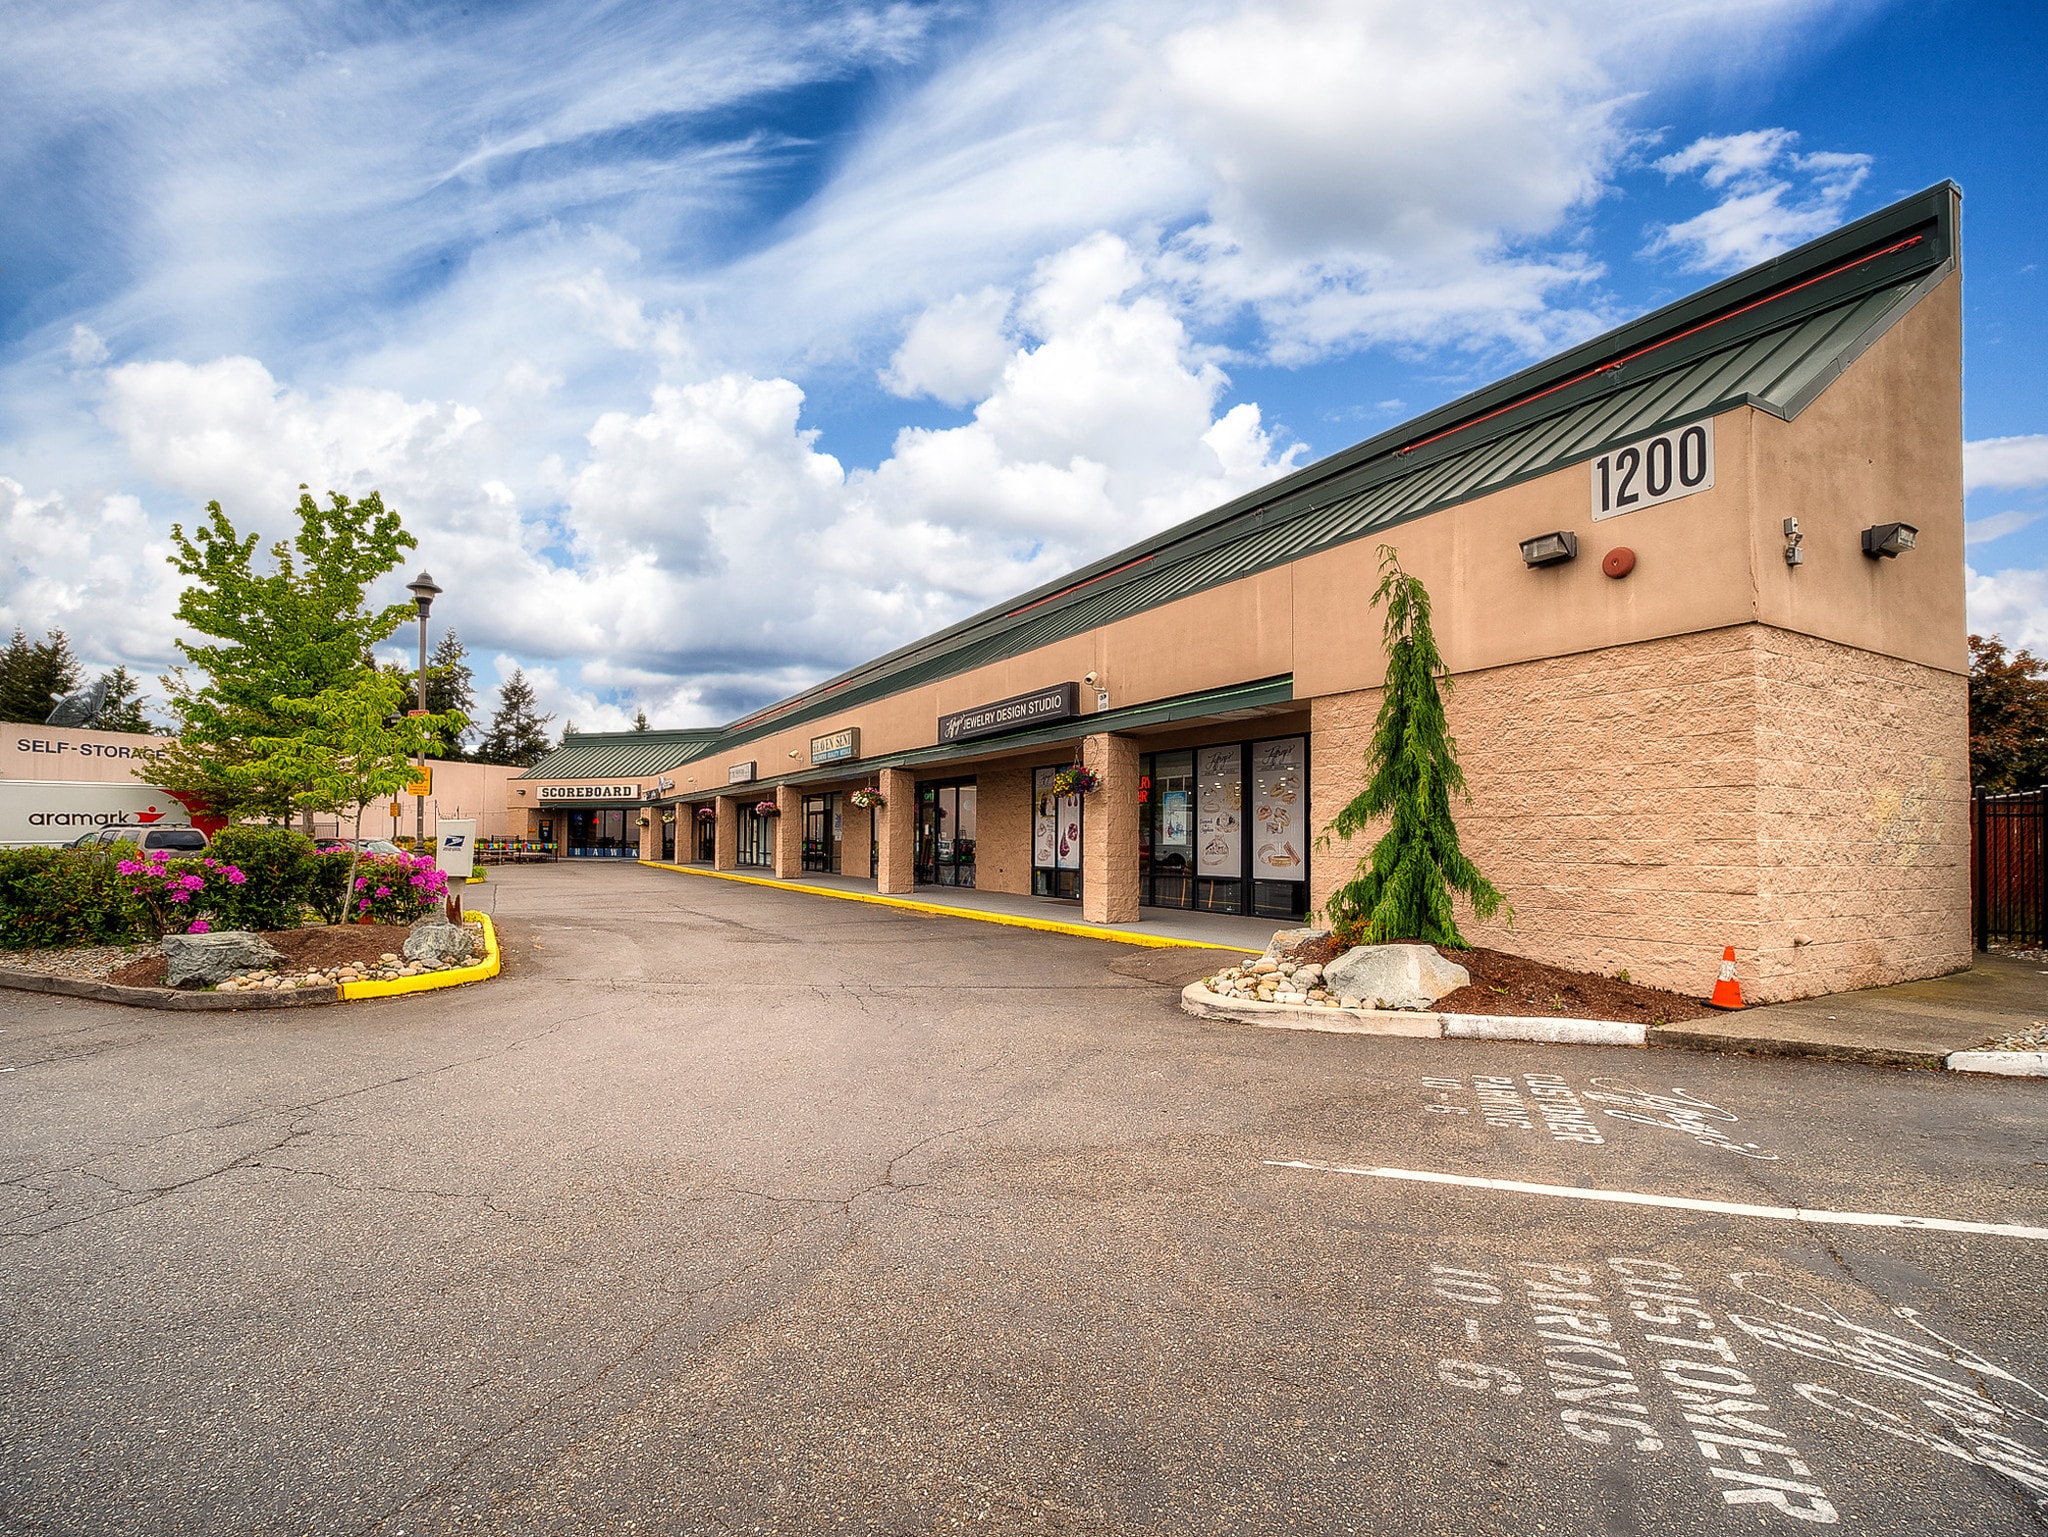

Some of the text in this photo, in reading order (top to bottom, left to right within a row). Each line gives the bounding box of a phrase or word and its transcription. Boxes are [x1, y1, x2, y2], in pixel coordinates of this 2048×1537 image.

[1597, 425, 1707, 512] 1200
[963, 711, 995, 730] JEWELRY
[996, 703, 1027, 722] DESIGN
[1028, 695, 1062, 716] STUDIO
[28, 810, 130, 826] aramark
[542, 786, 632, 798] SCOREBOARD
[1471, 1075, 1534, 1129] PARKING
[1523, 1073, 1606, 1144] CUSTOMER
[1519, 1261, 1664, 1452] PARKING
[1607, 1256, 1839, 1525] CUSTOMER
